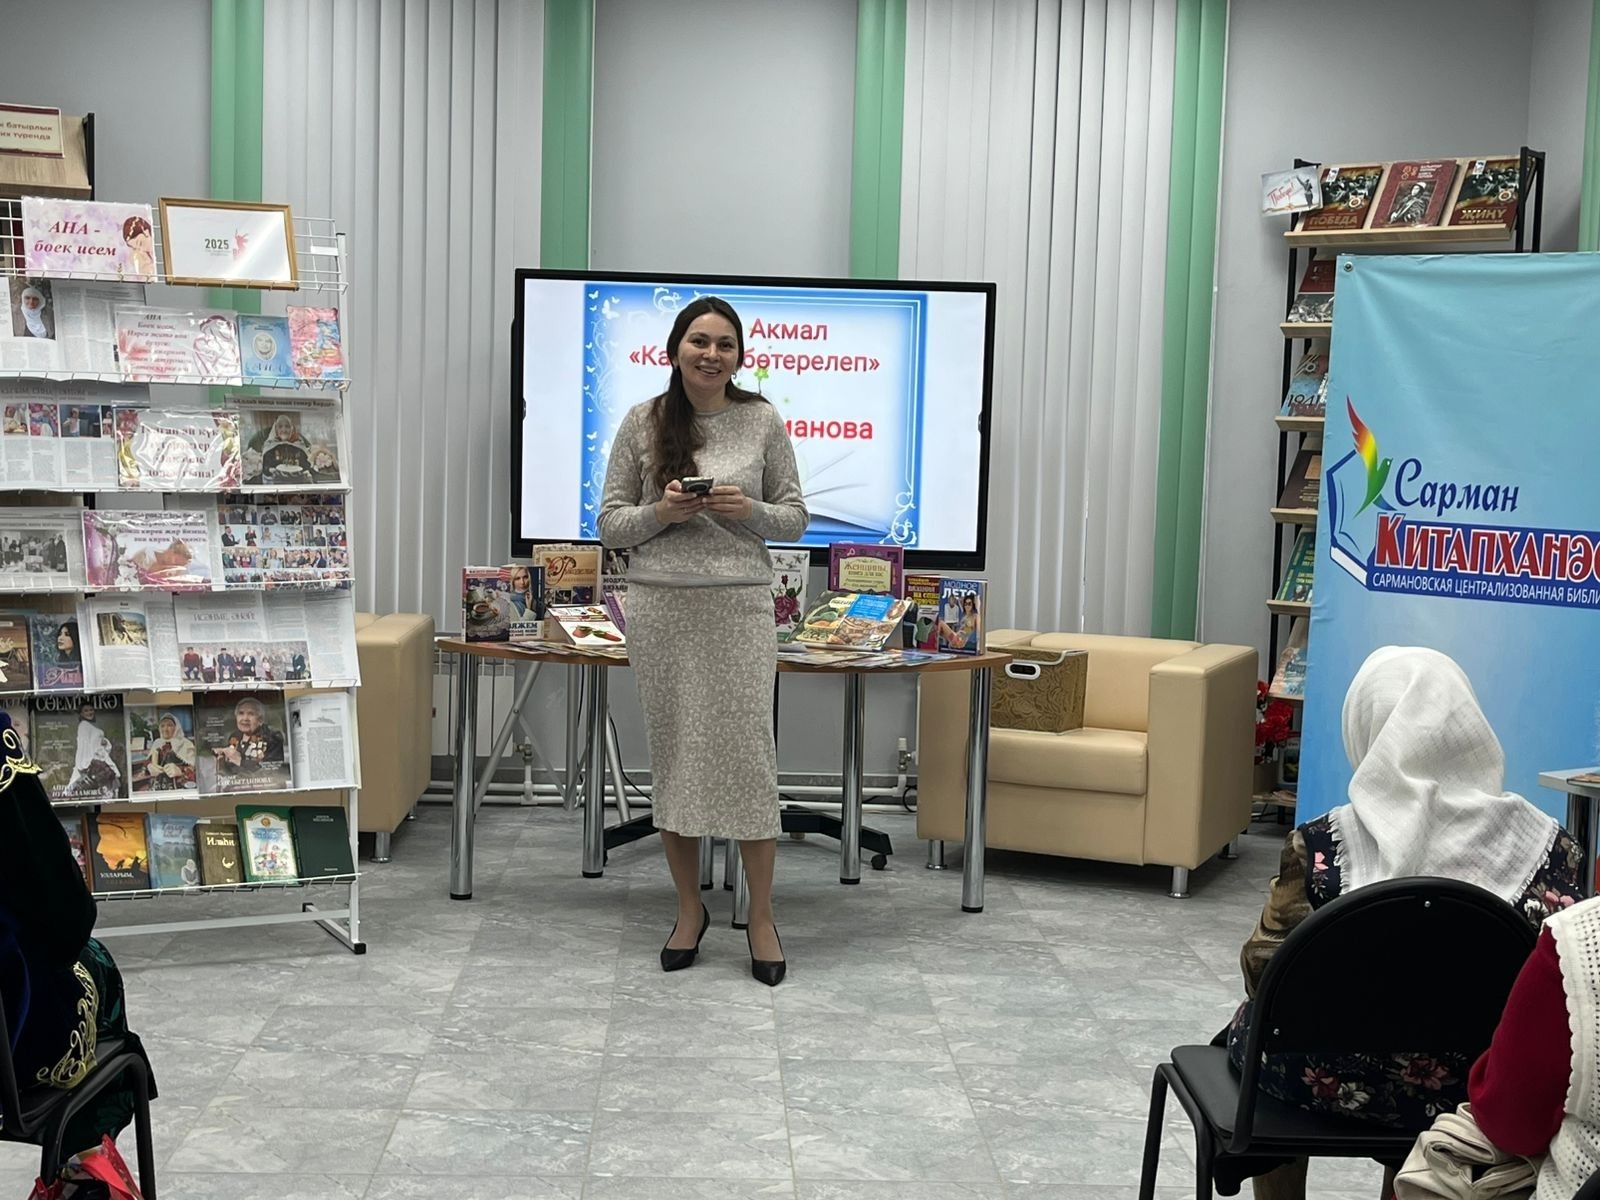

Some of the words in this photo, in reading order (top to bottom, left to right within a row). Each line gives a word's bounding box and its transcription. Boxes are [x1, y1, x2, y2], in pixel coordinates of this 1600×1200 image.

[48, 220, 88, 235] АНА
[1308, 215, 1358, 226] ПОБЕДА
[77, 243, 116, 256] исем
[204, 238, 229, 250] 2025
[749, 318, 828, 340] Акмал
[743, 347, 881, 375] бөтерелеп»
[1287, 394, 1321, 408] 1941
[1395, 457, 1520, 517] Сарман
[1372, 572, 1453, 593] САРМАНОВСКАЯ
[1454, 579, 1564, 602] ЦЕНТРАЛИЗОВАННАЯ
